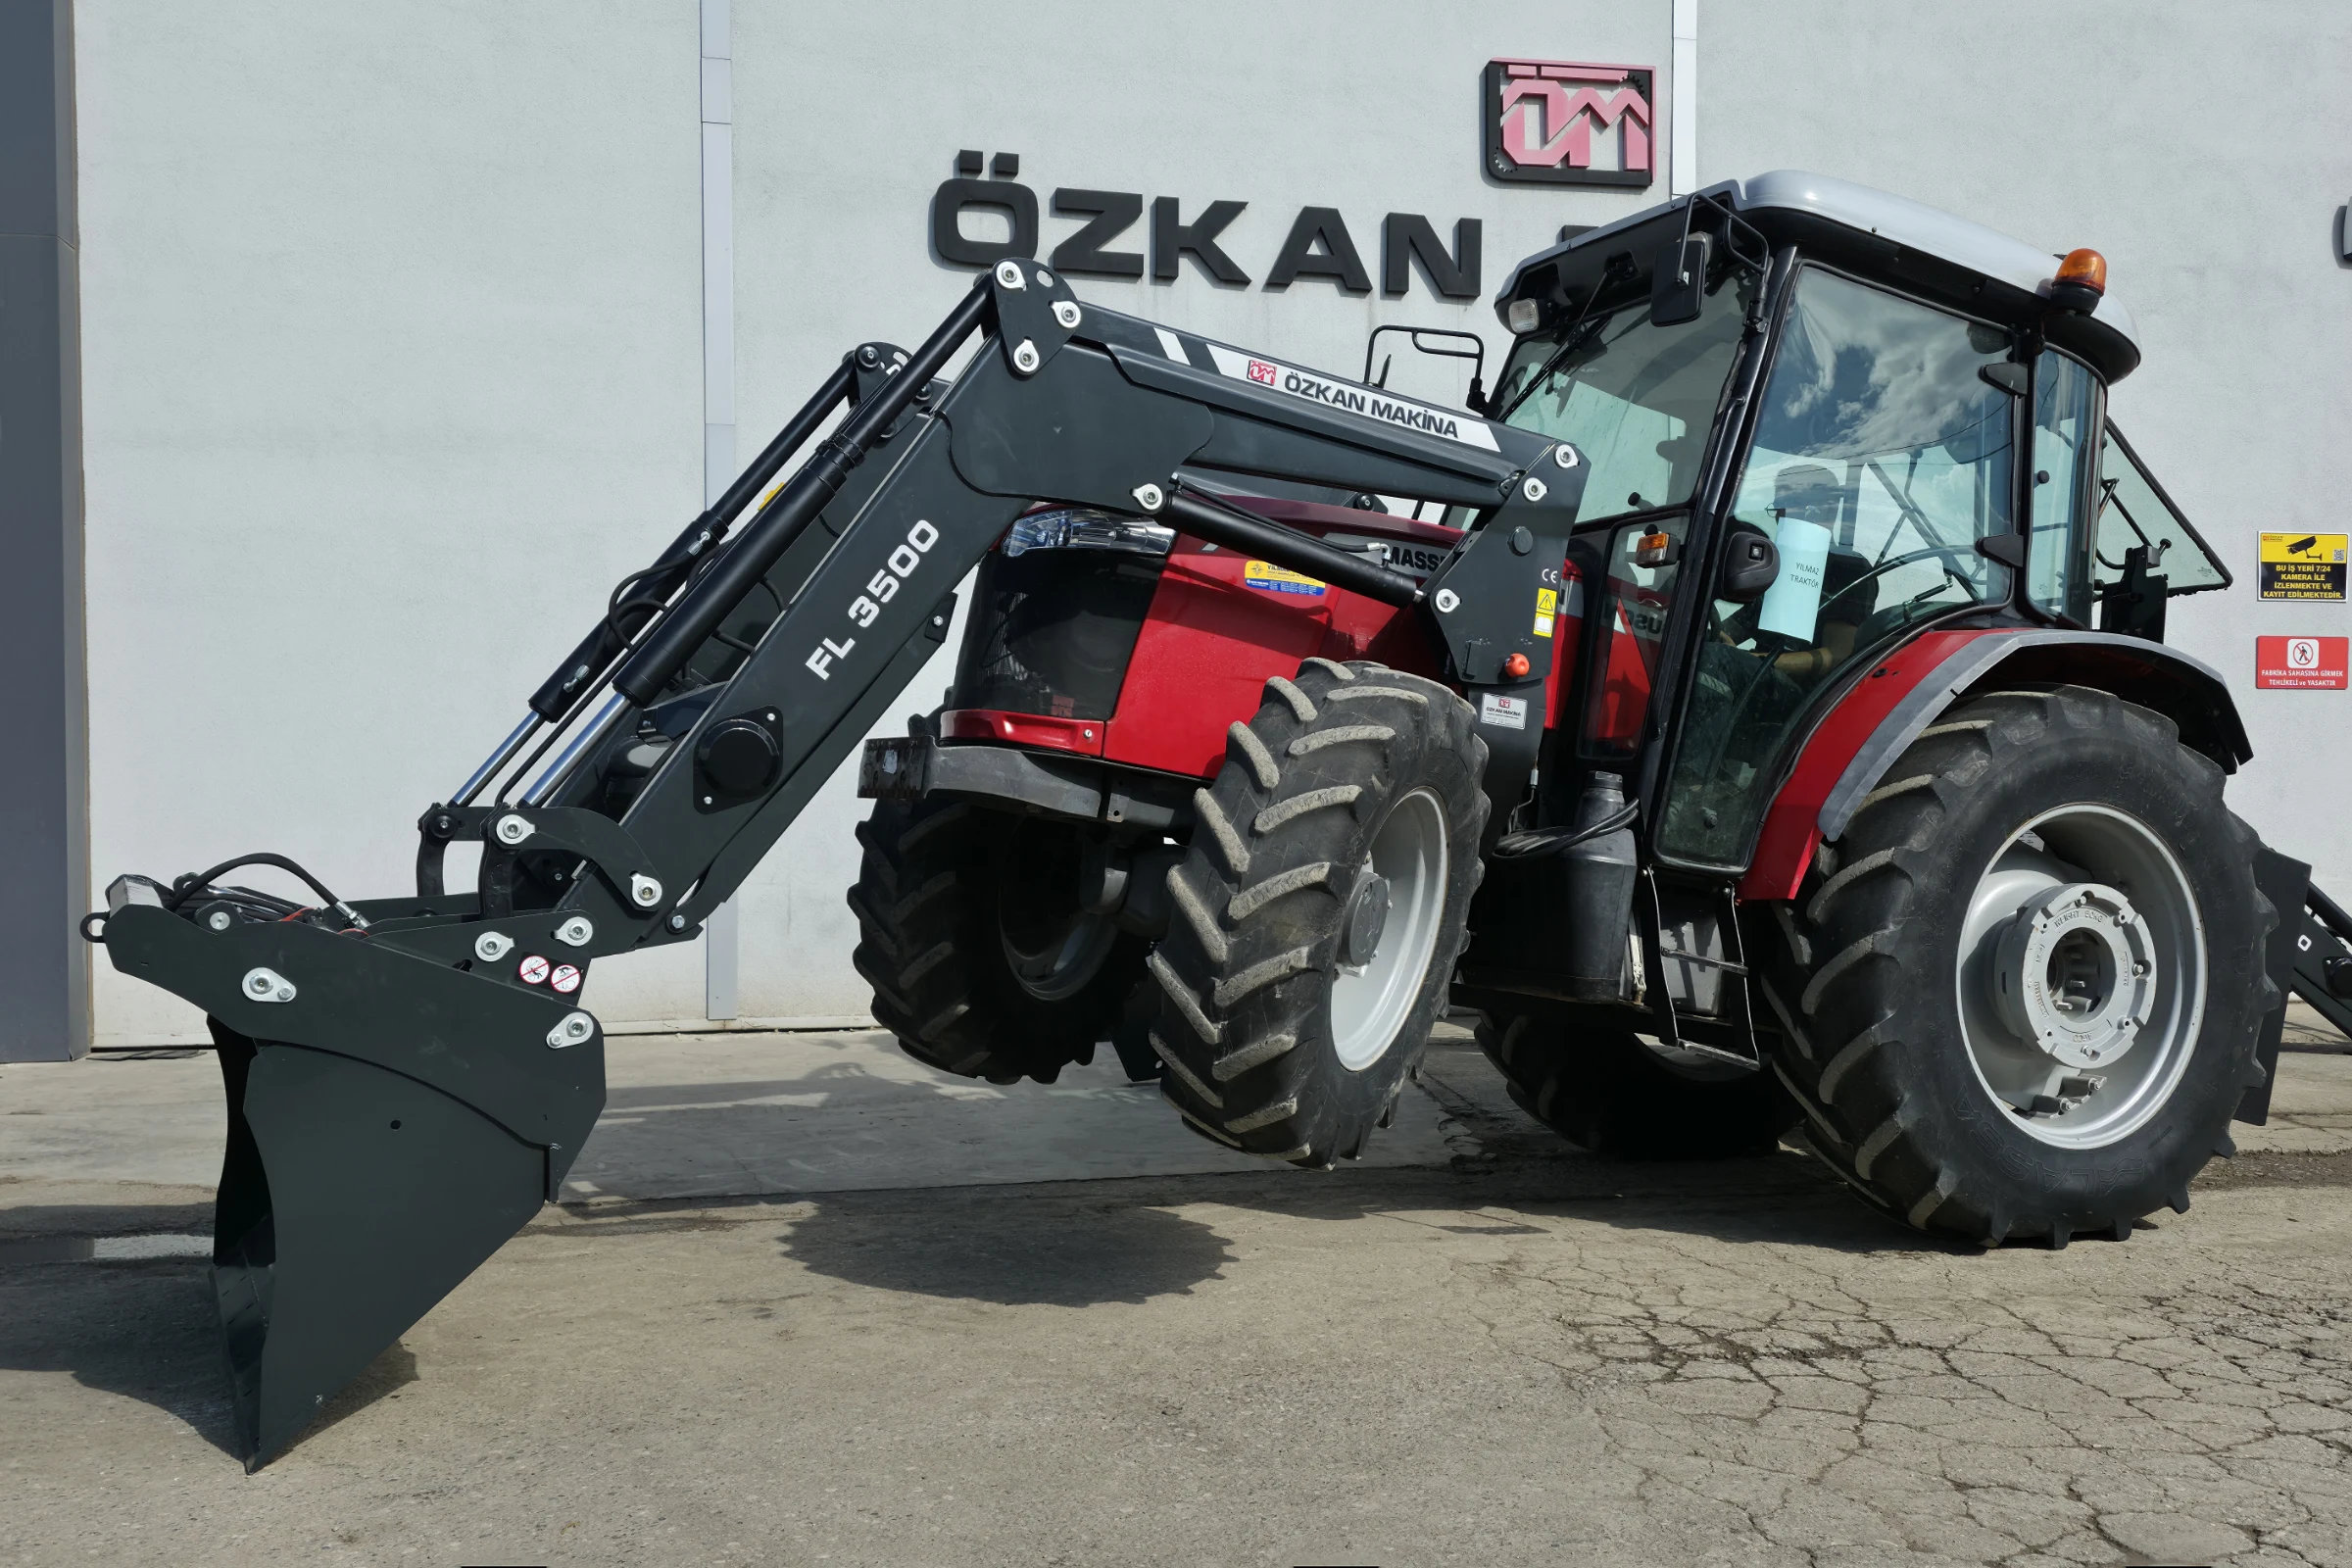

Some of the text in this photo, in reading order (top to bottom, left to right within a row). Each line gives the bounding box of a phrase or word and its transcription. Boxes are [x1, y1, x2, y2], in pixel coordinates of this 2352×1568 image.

[932, 149, 1482, 298] ÖZKAN
[1284, 370, 1365, 414] ÖZKAN
[1370, 399, 1459, 440] MAKİNA
[2288, 564, 2295, 572] İŞ
[2297, 564, 2314, 572] YERİ
[2314, 572, 2326, 581] İLE
[2274, 581, 2321, 590] İZLENMEKTE
[805, 519, 939, 681] FL 3500
[2287, 590, 2343, 599] EDİLMEKTEDİR.
[2053, 910, 2081, 928] WEIGHT
